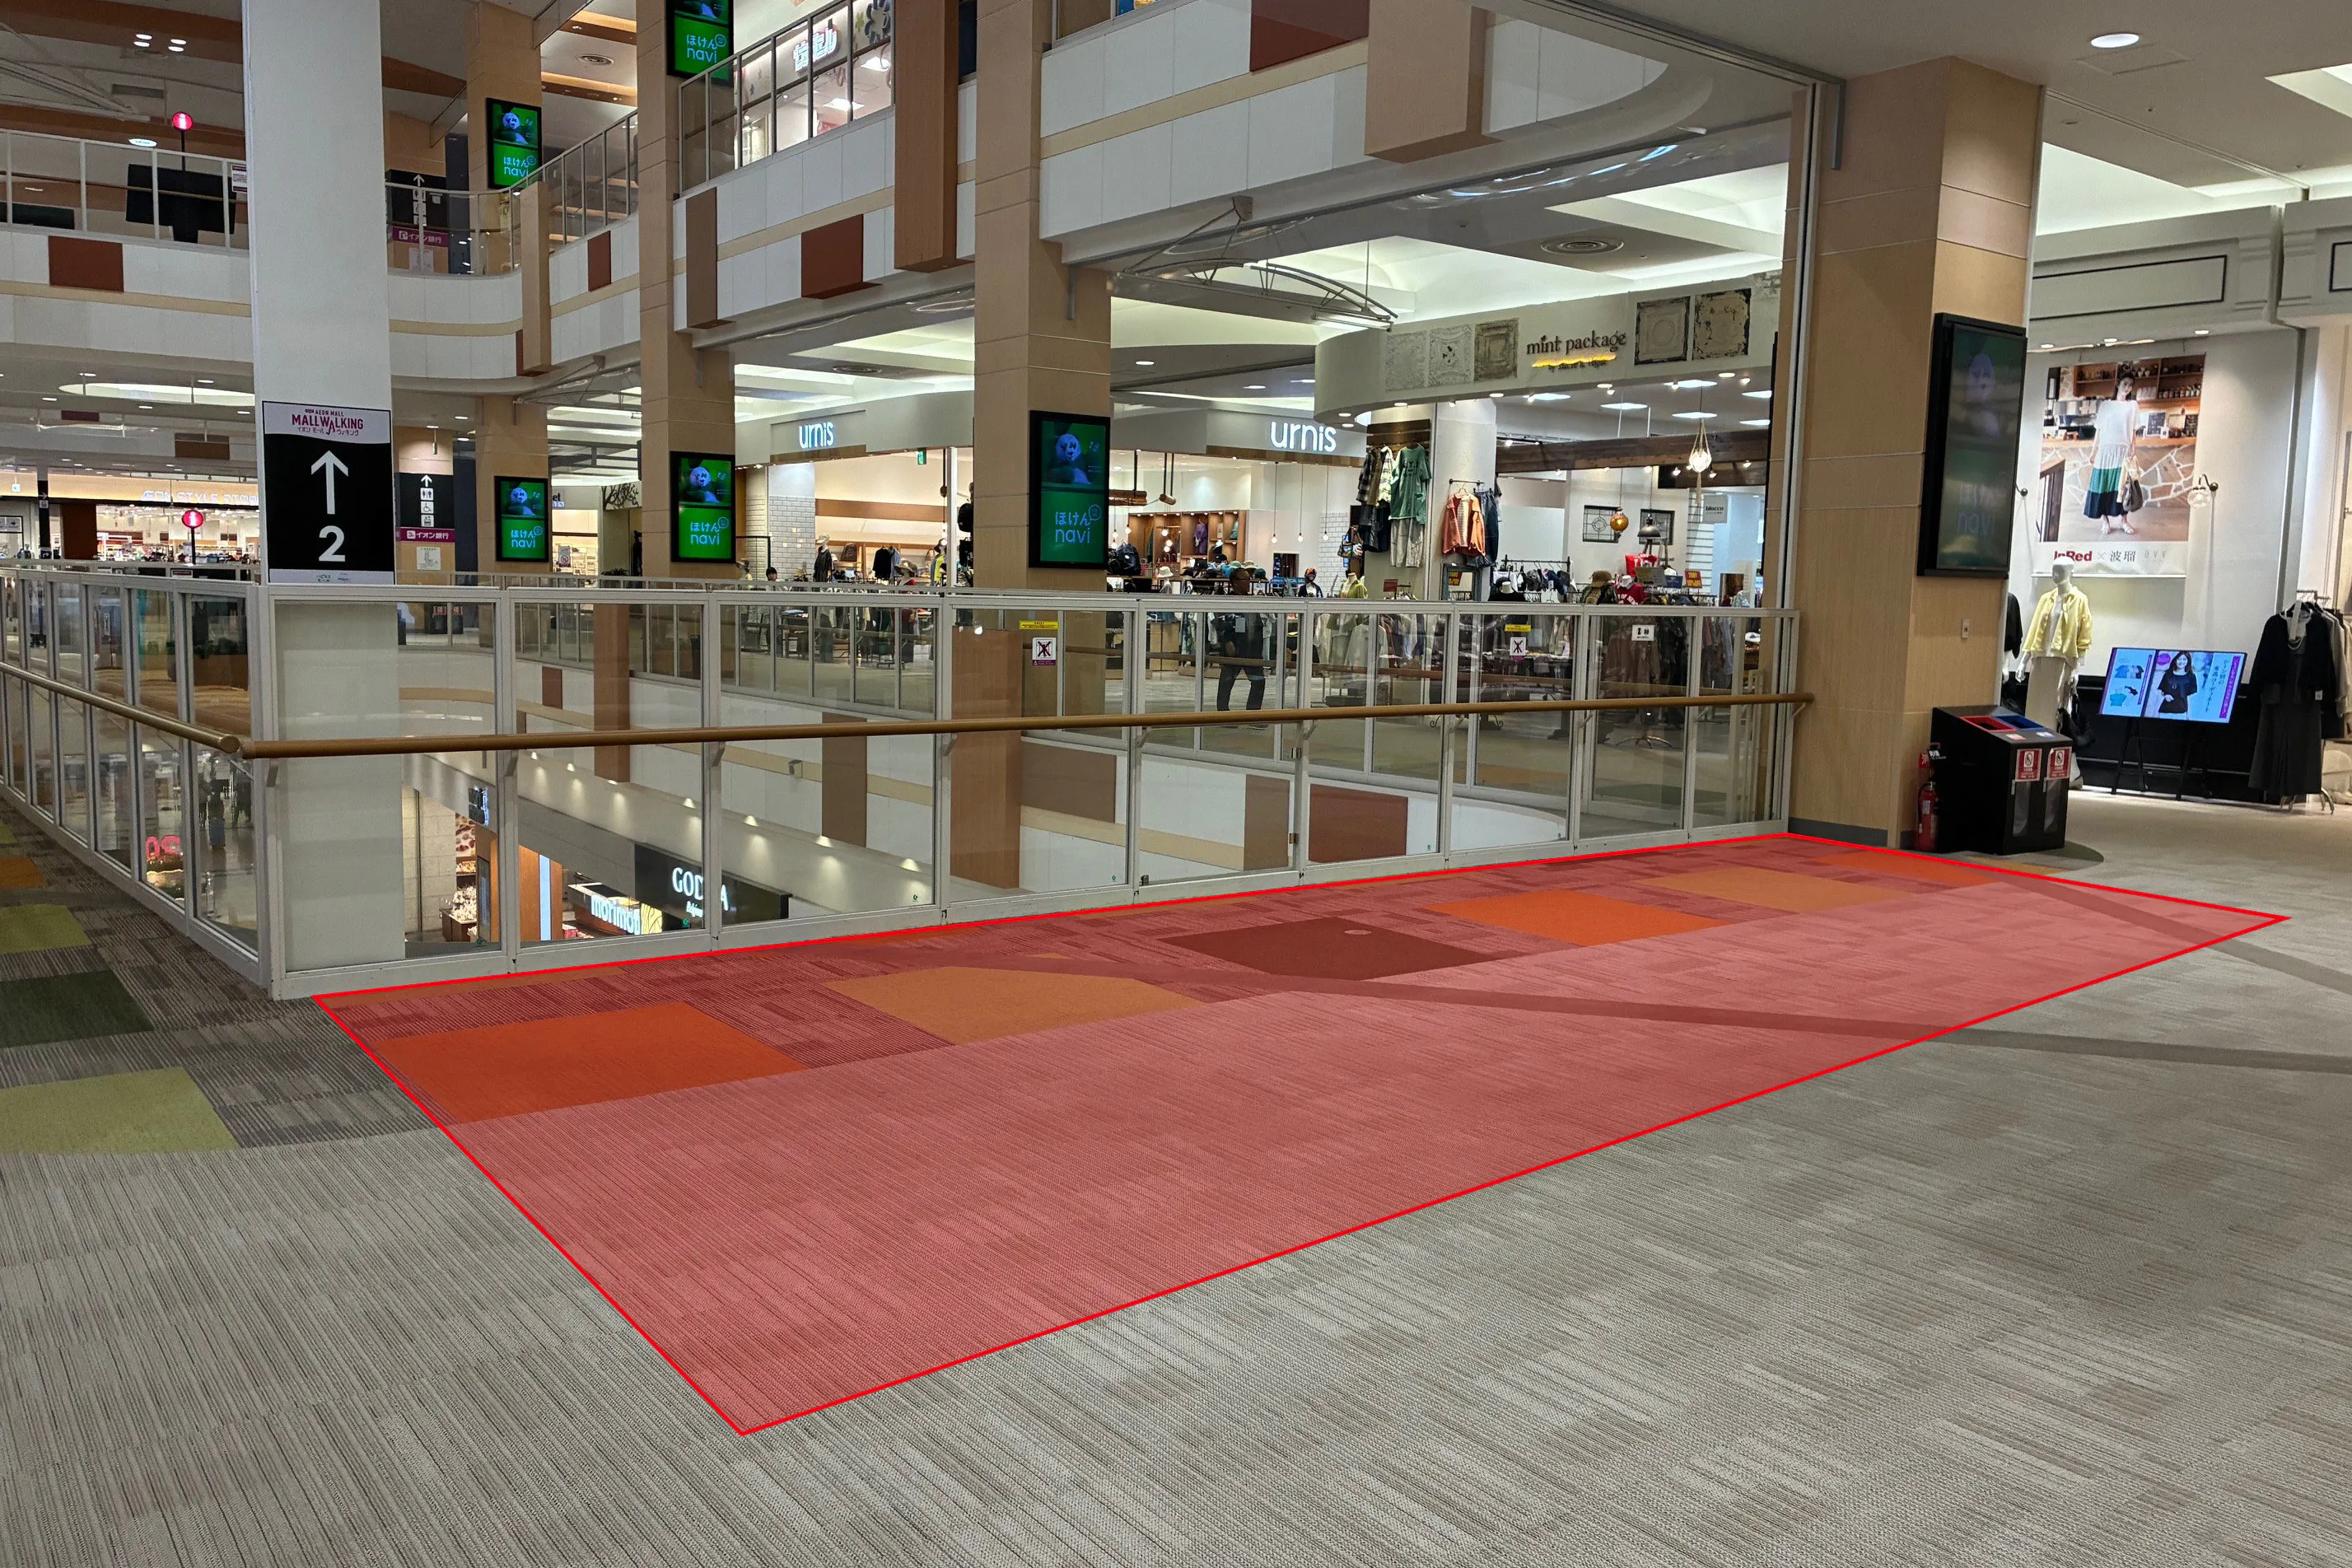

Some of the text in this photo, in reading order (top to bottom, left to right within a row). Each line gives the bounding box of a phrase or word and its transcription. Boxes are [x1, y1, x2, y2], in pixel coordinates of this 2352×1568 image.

[686, 35, 718, 49] ほけん
[687, 48, 717, 63] navi
[503, 156, 530, 167] ほけん
[504, 166, 529, 177] navi
[1526, 329, 1626, 356] mint package
[799, 422, 833, 449] urnis
[1271, 422, 1337, 452] urnis
[1055, 511, 1090, 526] ほけん
[690, 521, 720, 533] ほけん
[416, 531, 449, 540] イオン銀行
[511, 530, 535, 539] ほけん
[690, 534, 720, 545] navi
[1055, 527, 1090, 544] navi
[319, 525, 345, 562] 2
[511, 539, 535, 548] navi
[2110, 550, 2135, 562] 波瑠
[672, 867, 729, 912] GODA
